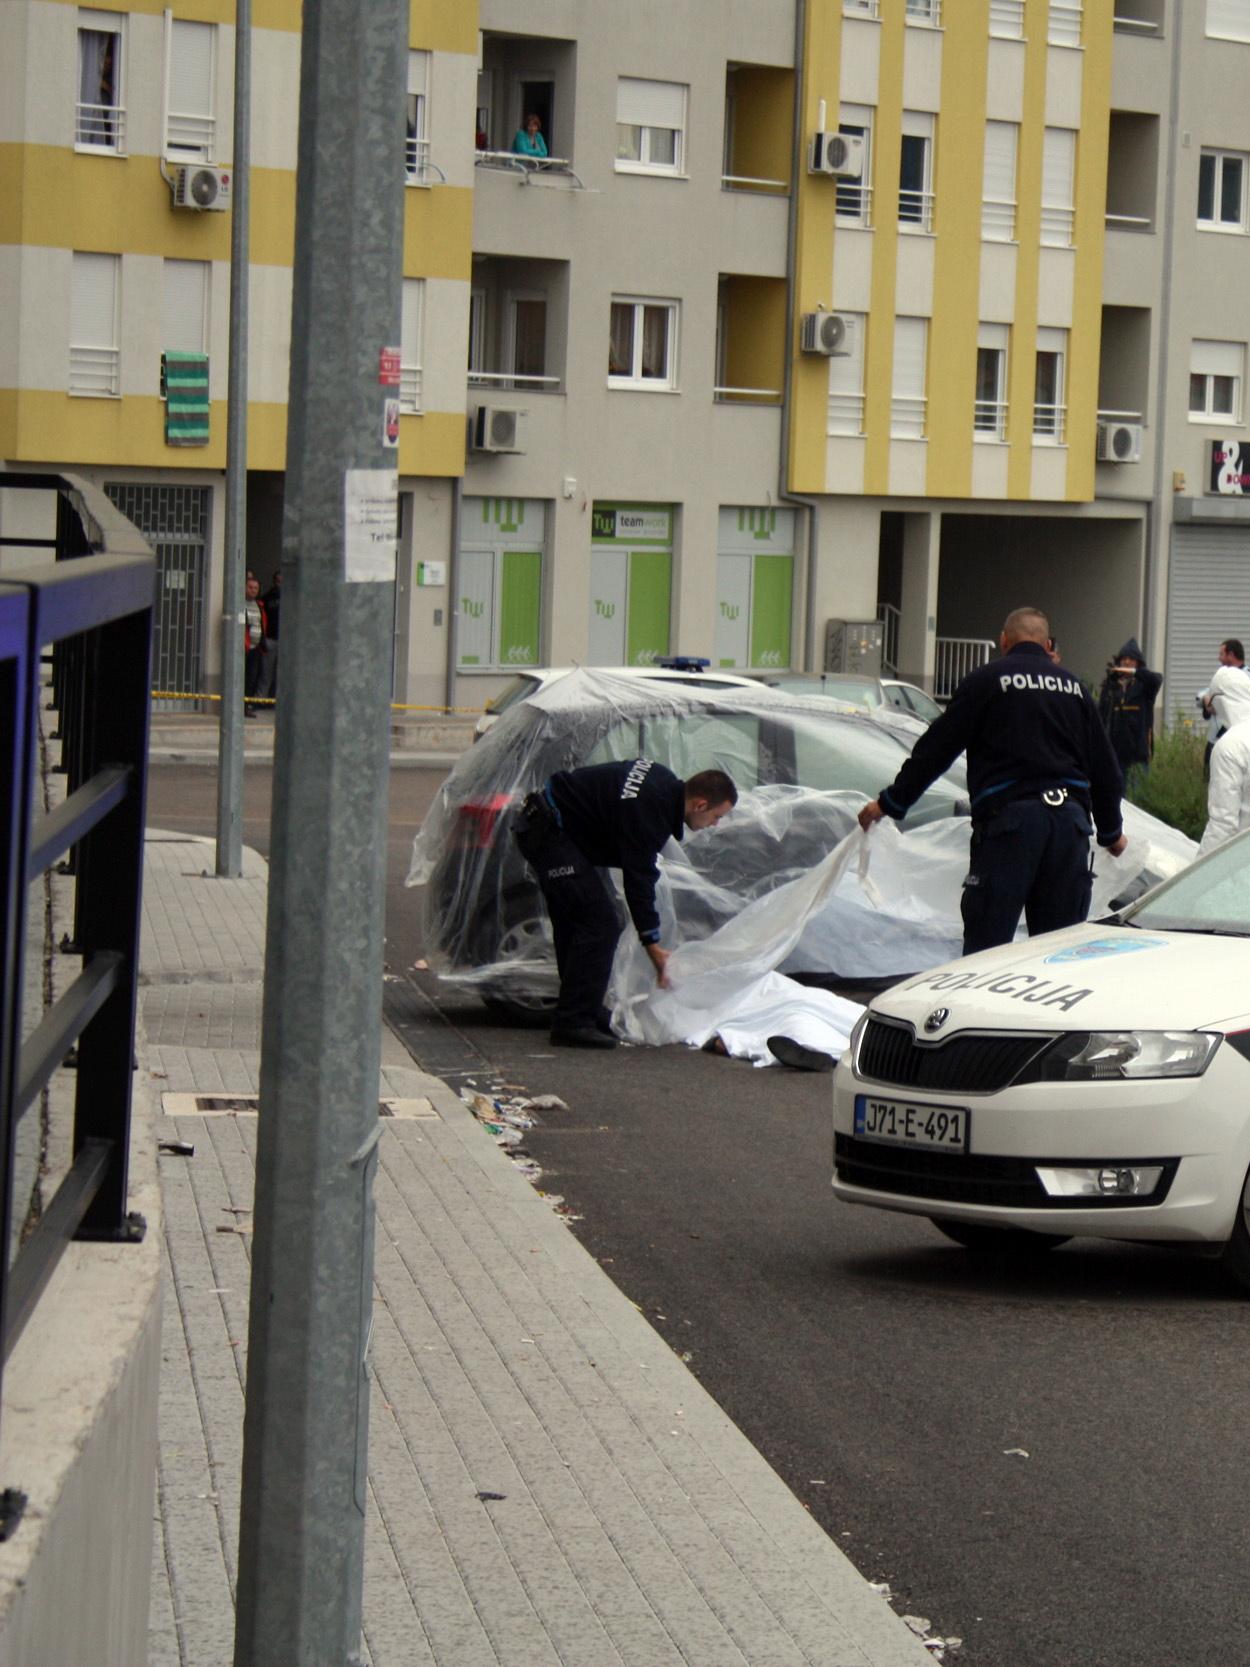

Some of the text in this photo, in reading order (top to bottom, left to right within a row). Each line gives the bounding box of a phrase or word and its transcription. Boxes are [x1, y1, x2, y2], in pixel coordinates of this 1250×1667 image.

[1000, 673, 1083, 699] POLICIJA
[904, 972, 1095, 1012] POLICIJA
[866, 1103, 961, 1144] J71-E-491
